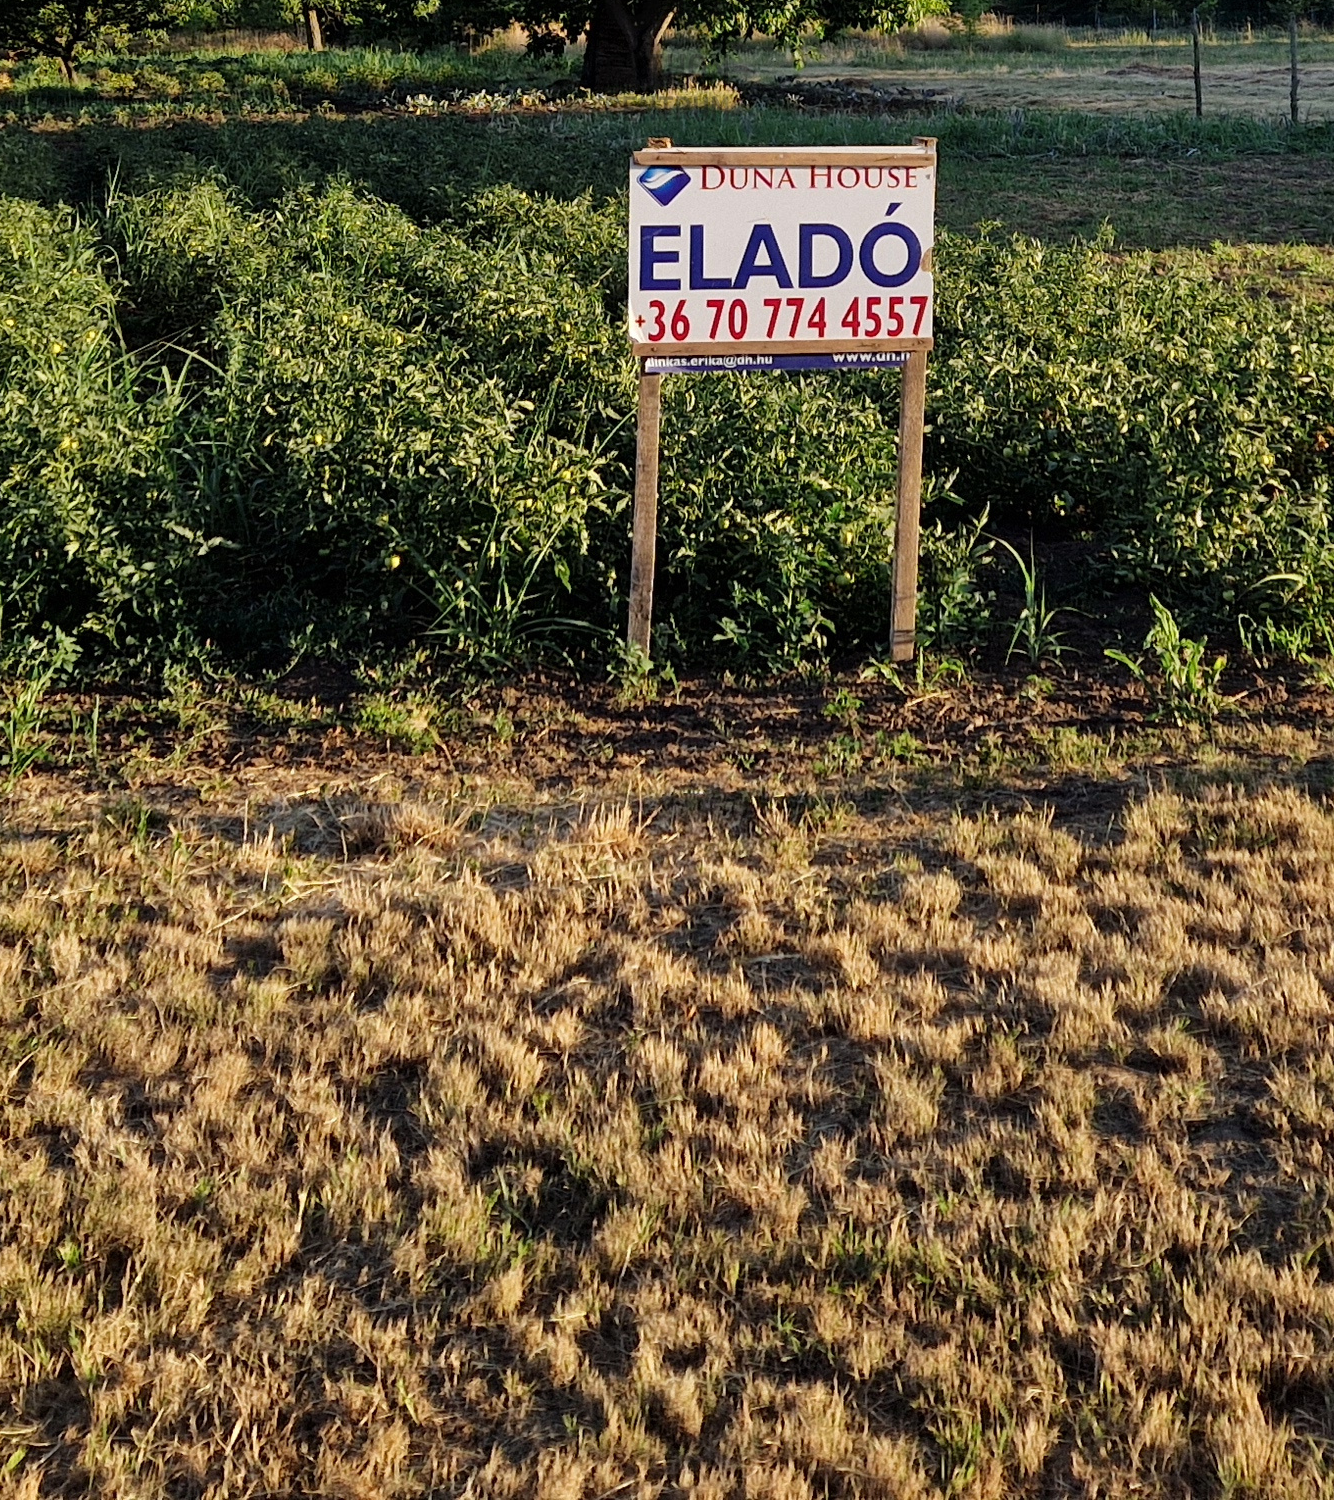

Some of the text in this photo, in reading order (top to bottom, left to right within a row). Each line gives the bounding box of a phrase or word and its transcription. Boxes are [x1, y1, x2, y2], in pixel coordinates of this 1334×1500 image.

[701, 167, 917, 190] DUNA HOUSE
[639, 202, 921, 291] ELADÓ
[635, 296, 928, 341] +36 70 774 4557
